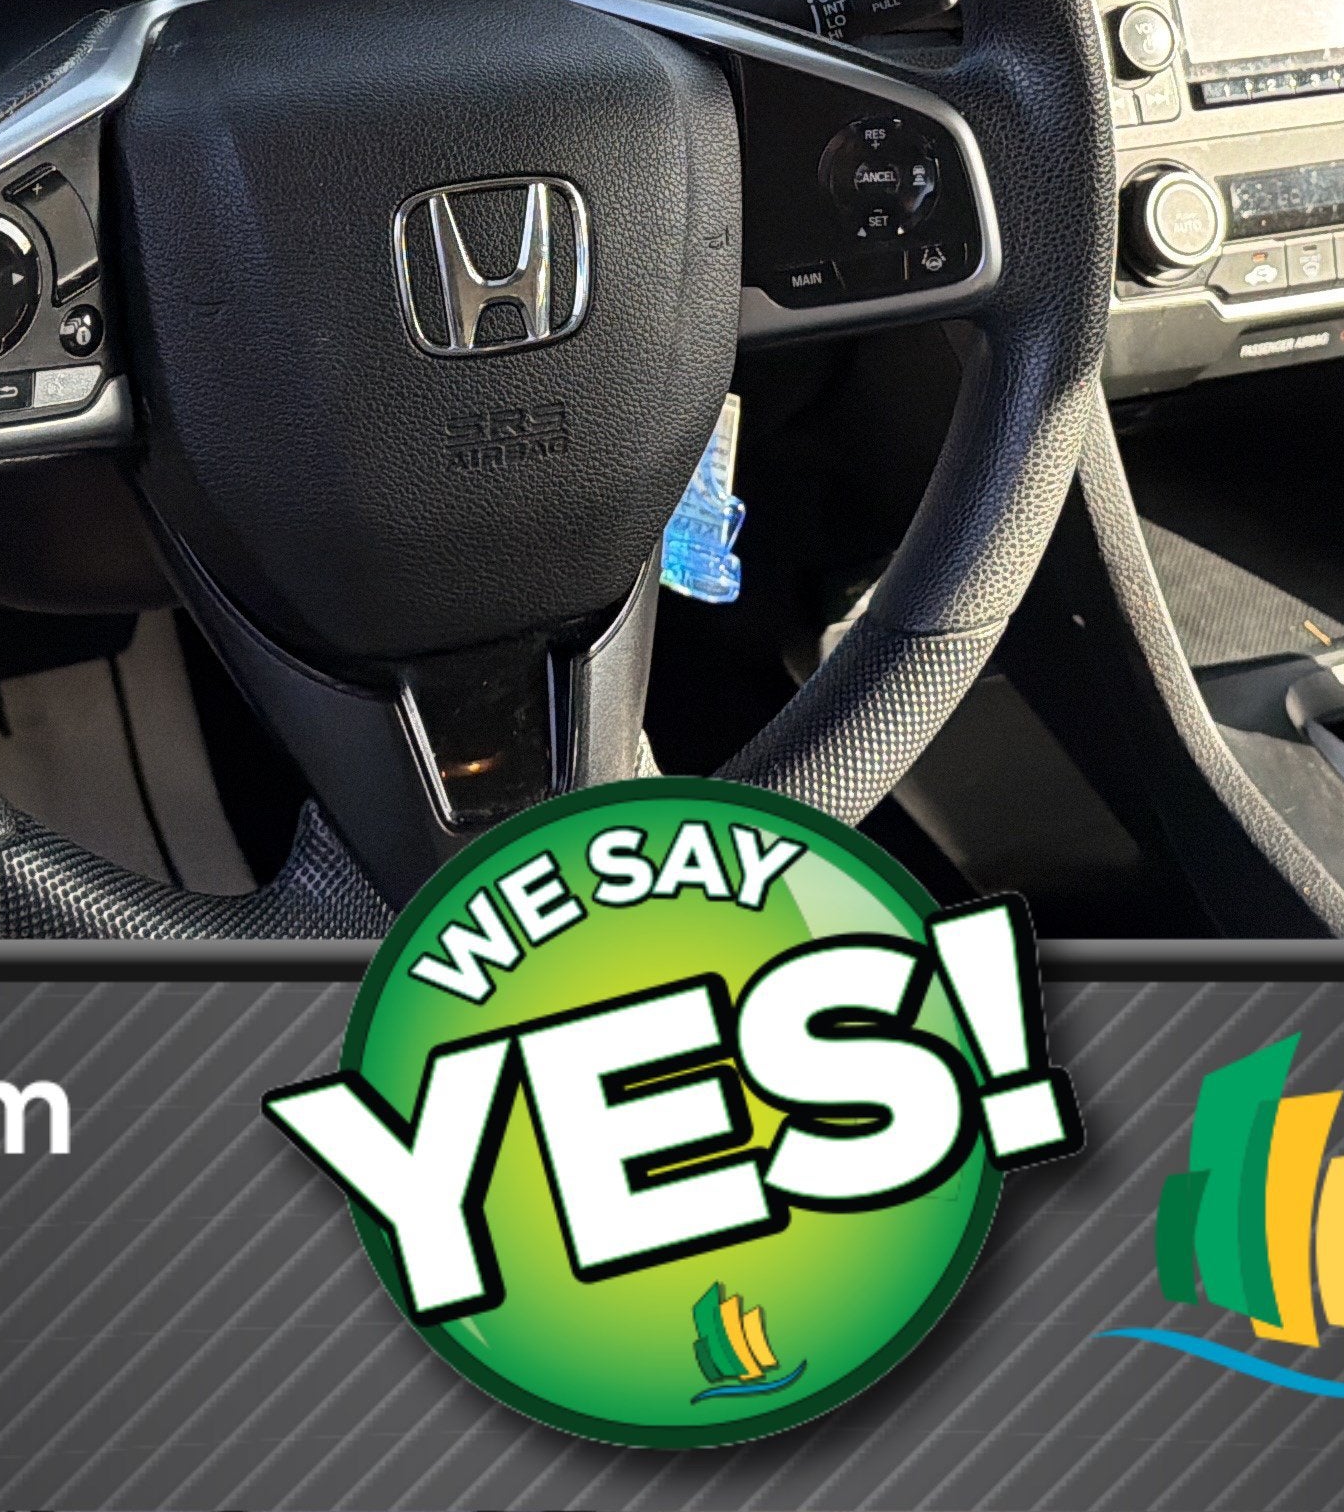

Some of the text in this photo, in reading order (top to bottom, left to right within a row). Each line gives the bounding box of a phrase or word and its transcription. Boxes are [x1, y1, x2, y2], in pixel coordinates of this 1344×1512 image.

[823, 0, 846, 16] INT
[871, 0, 902, 13] PULL
[826, 14, 847, 29] LO
[827, 28, 844, 39] HI
[864, 129, 887, 140] RES
[856, 170, 897, 183] CANCEL
[868, 215, 889, 227] SET
[791, 272, 823, 288] MAIN
